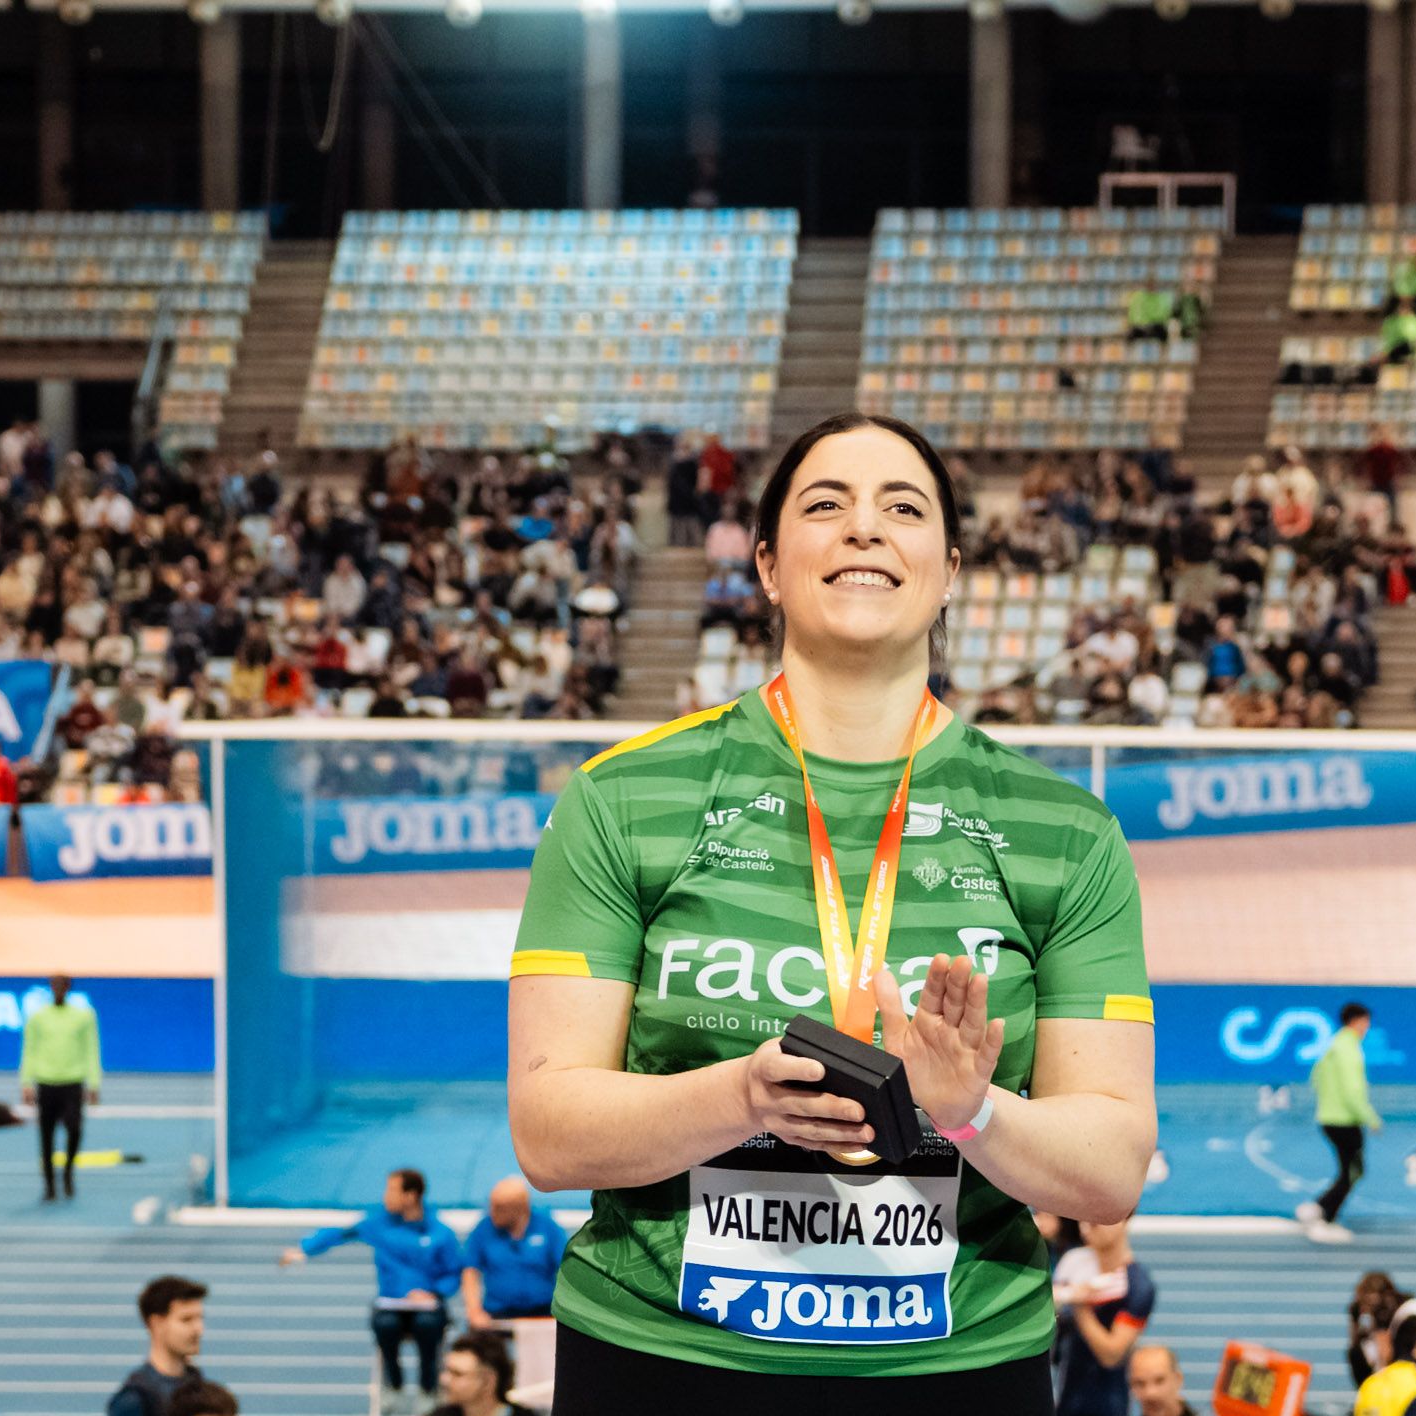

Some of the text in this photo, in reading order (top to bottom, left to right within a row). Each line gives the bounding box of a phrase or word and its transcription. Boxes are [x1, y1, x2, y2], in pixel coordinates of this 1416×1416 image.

[1157, 755, 1374, 831] Joma
[58, 803, 213, 875] Jom
[331, 797, 539, 864] Joma
[708, 841, 769, 860] Diputació
[705, 855, 775, 872] de Castelló
[656, 938, 934, 1017] Faca
[686, 1011, 740, 1030] ciclo
[702, 1192, 944, 1247] VALENCIA 2026
[751, 1280, 933, 1332] Joma
